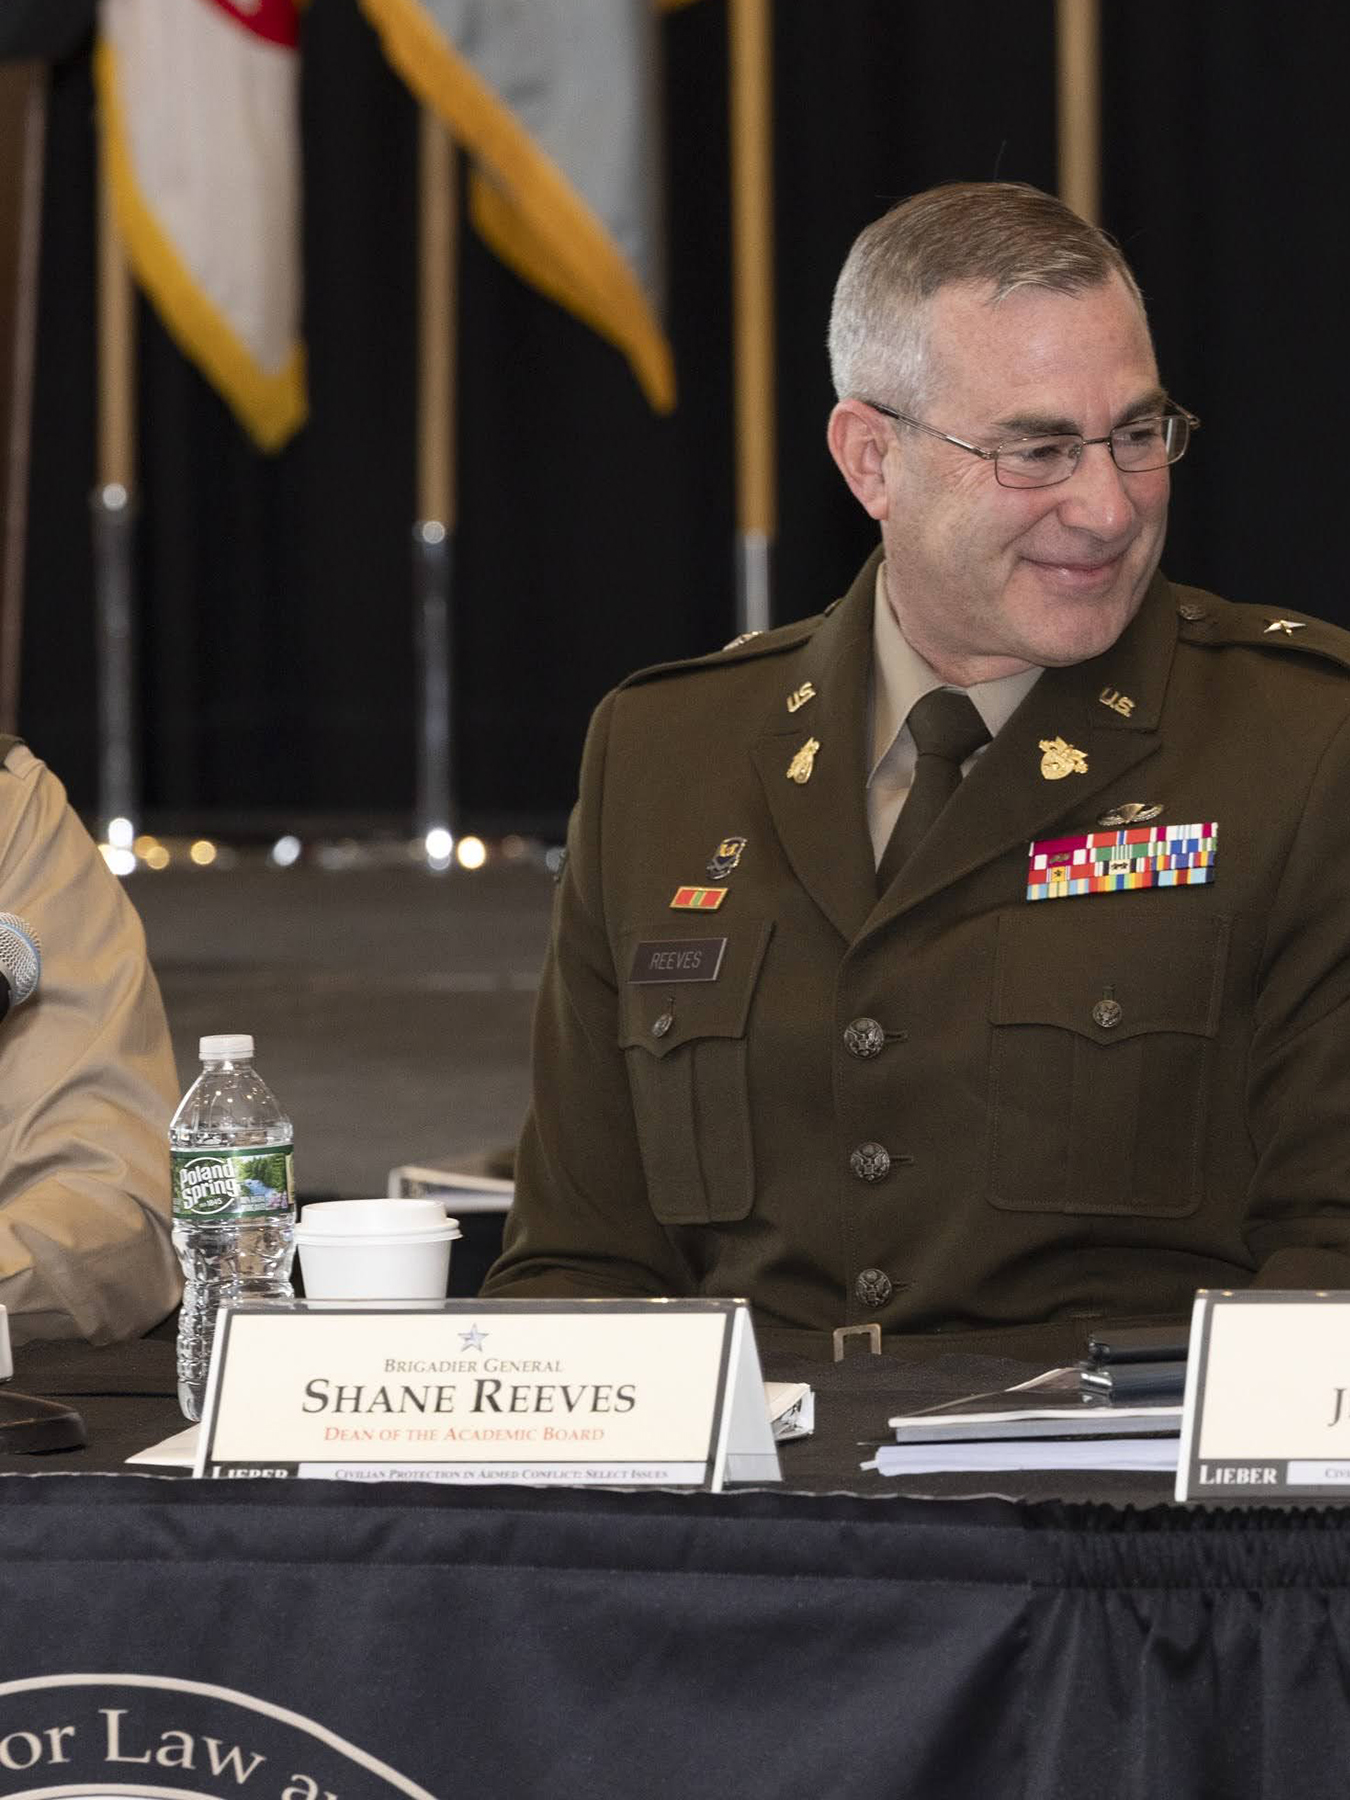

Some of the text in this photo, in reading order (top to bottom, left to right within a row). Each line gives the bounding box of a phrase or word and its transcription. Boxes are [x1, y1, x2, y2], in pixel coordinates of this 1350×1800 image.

[649, 951, 702, 970] REEVES
[180, 1158, 236, 1189] Poland
[182, 1179, 240, 1209] Spring
[384, 1357, 564, 1373] BRIGADIER GENERAL
[302, 1378, 637, 1414] SHANE REEVES
[324, 1426, 605, 1441] DEAN OF THE ACADEMIC BOARD
[334, 1468, 386, 1480] CIVILIAN
[389, 1468, 459, 1480] PROTECTION
[462, 1470, 475, 1480] IN
[477, 1468, 519, 1480] ARMED
[585, 1468, 628, 1480] SELECT
[631, 1468, 668, 1480] ISSUES
[1199, 1464, 1277, 1486] LIEBER
[98, 1708, 267, 1785] Law
